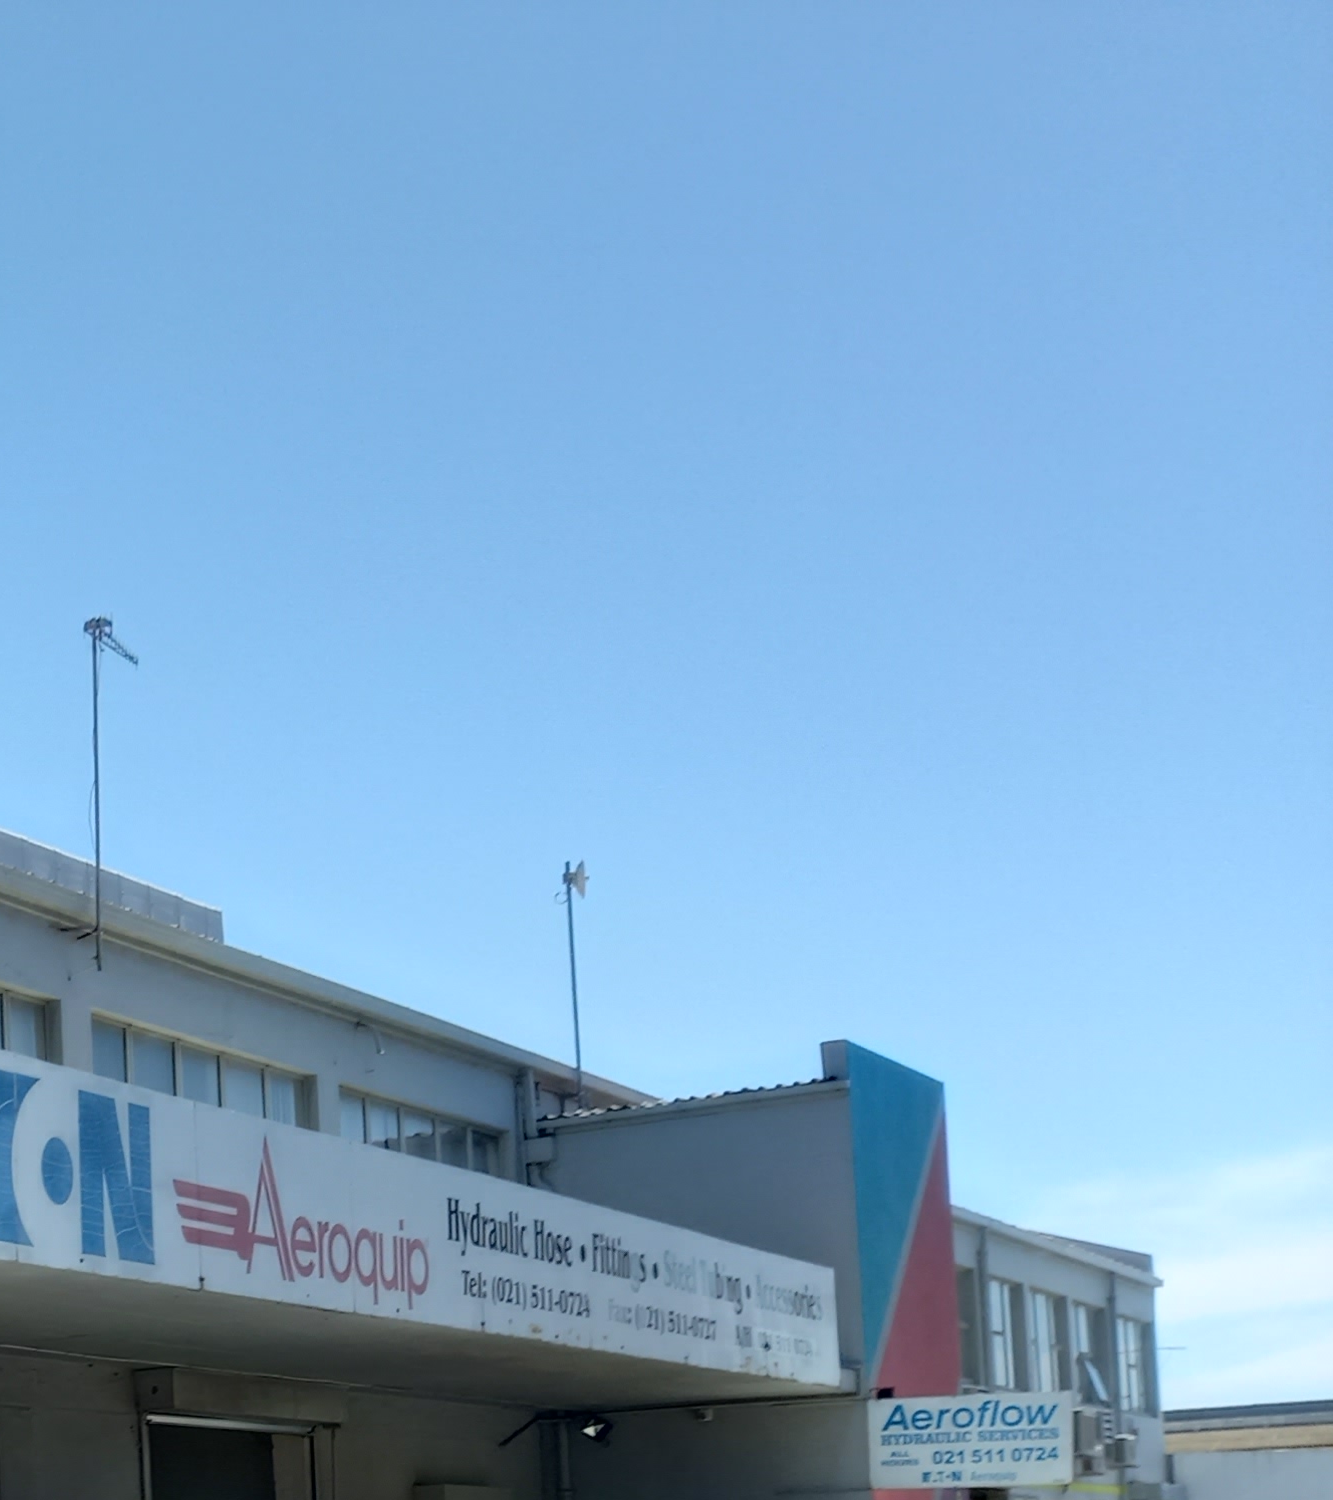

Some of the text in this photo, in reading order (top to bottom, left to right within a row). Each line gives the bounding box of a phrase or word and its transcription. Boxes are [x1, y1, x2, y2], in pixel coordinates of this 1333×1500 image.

[245, 1134, 429, 1310] Aeroquip
[446, 1197, 528, 1257] Hydraulic
[534, 1219, 573, 1267] Hose
[461, 1270, 487, 1299] Tel:
[492, 1276, 527, 1311] (021)
[531, 1284, 591, 1318] 511-0724
[881, 1400, 1058, 1432] Aeroflow
[881, 1427, 1060, 1446] HYDRAULIC SERVICES
[933, 1446, 1060, 1465] 021 511 0724
